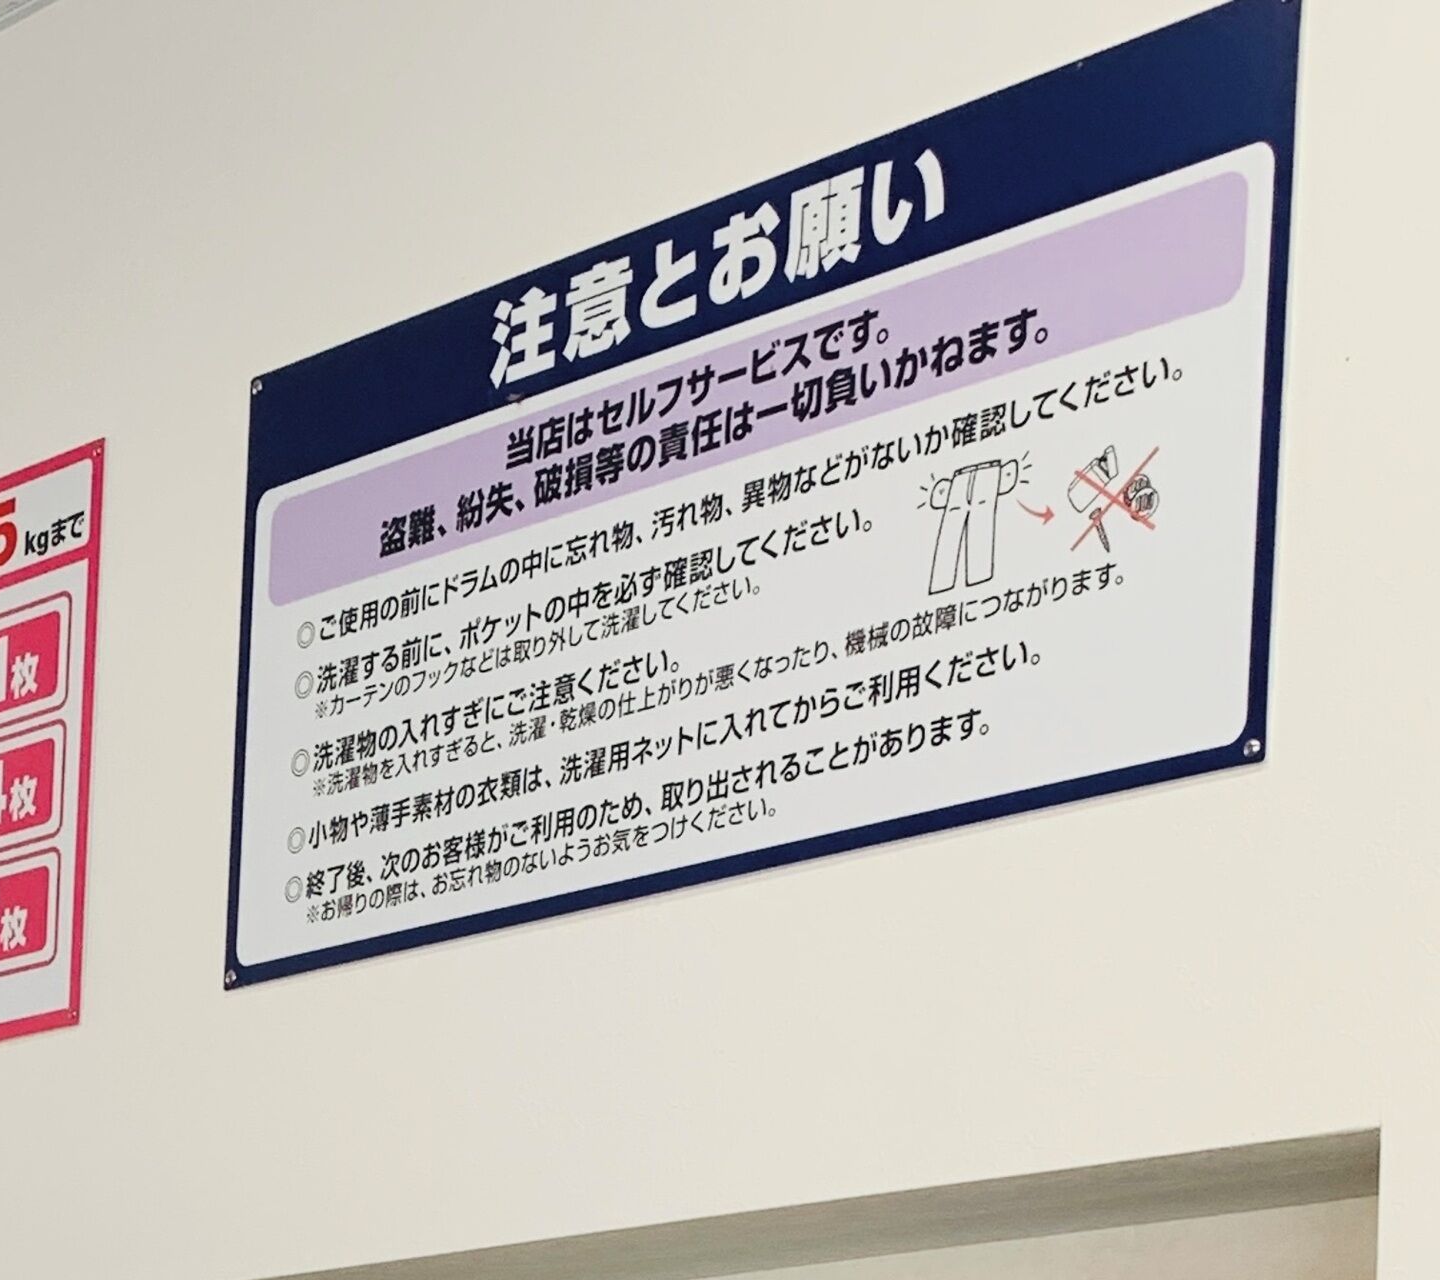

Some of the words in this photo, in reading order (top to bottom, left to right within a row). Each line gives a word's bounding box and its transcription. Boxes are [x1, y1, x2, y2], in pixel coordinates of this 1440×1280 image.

[490, 148, 947, 391] 注意とお願い
[380, 308, 1050, 558] 盗難、紛失、破損等の責任は一切負いかねます。
[505, 308, 890, 471] 当店はセルフサービスです。
[316, 509, 875, 694] 洗濯する前に、ポケットの中を必ず確認してください。
[313, 651, 682, 771] 洗濯物の入れすぎにご注意ください。
